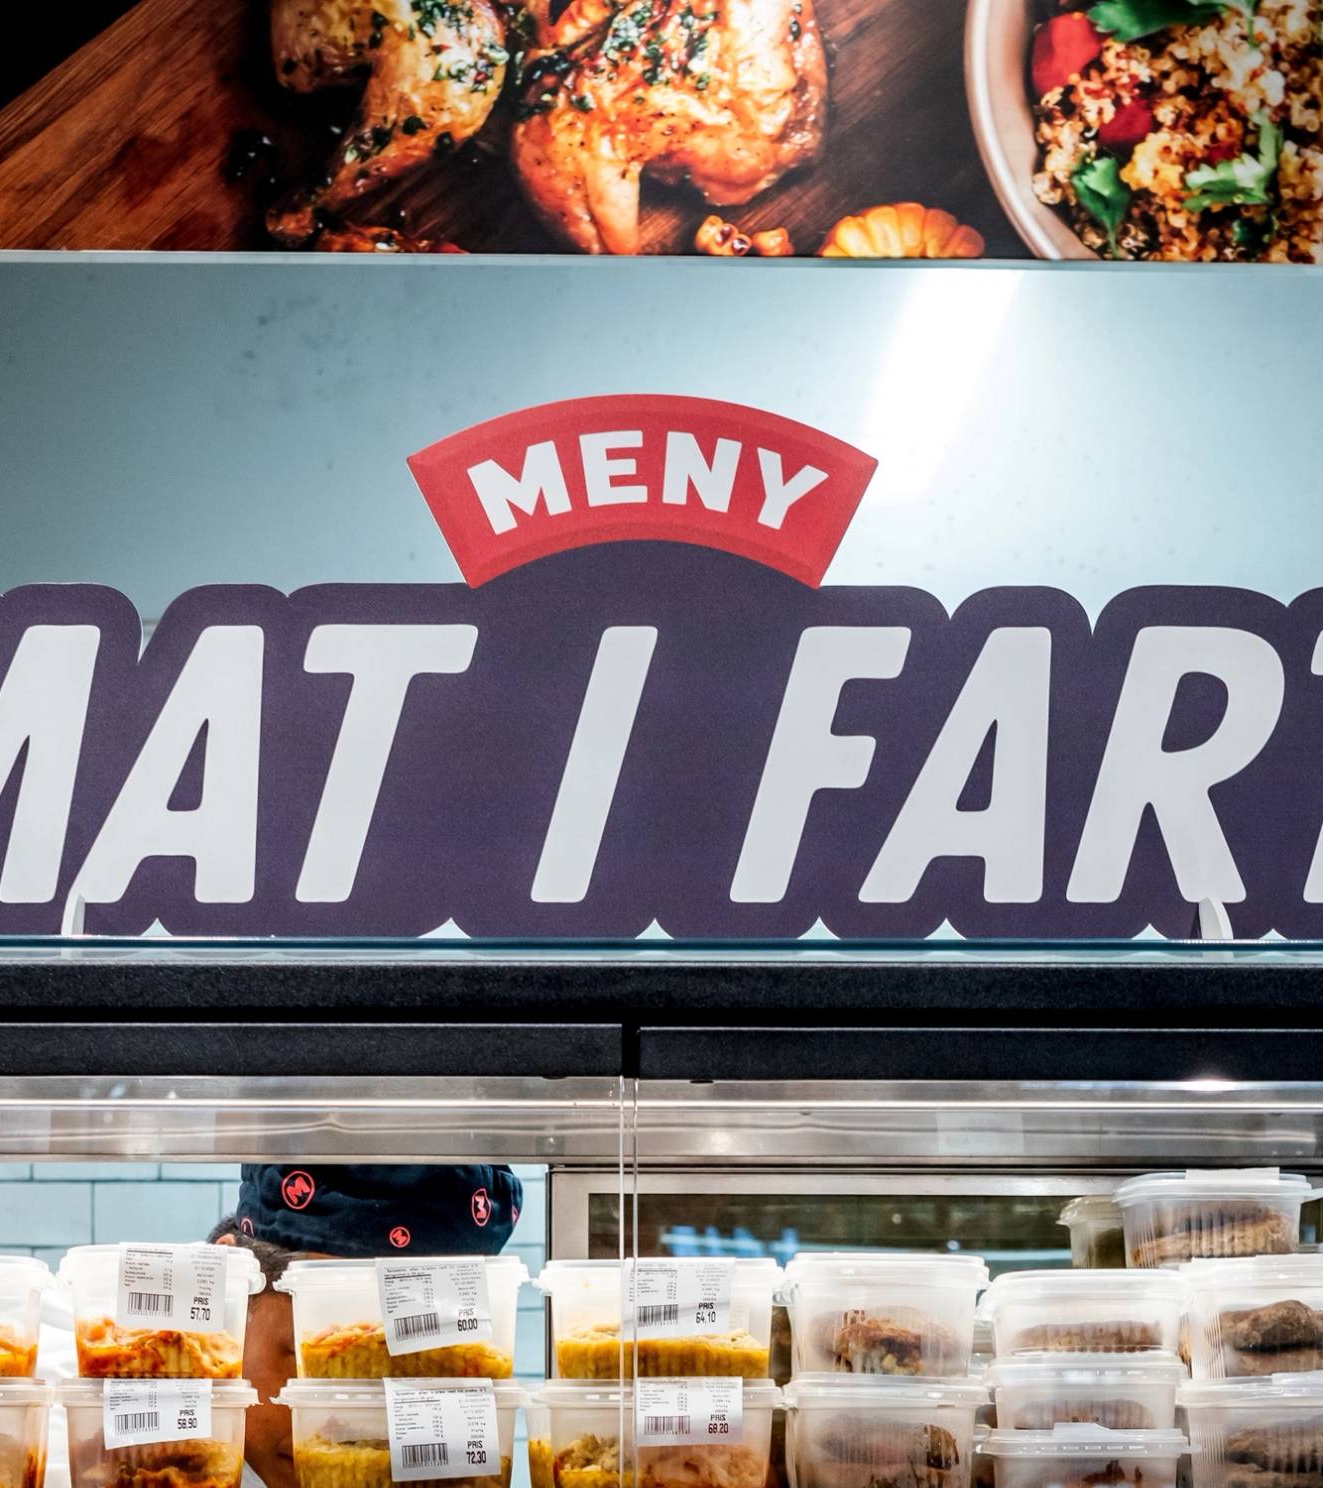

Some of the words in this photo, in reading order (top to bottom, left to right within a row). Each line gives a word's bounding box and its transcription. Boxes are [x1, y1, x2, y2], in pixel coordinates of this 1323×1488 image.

[466, 427, 834, 537] MENY
[528, 622, 662, 908] I
[193, 1297, 209, 1305] PRIS
[698, 1302, 714, 1310] PRIS
[467, 1441, 483, 1449] PRIS
